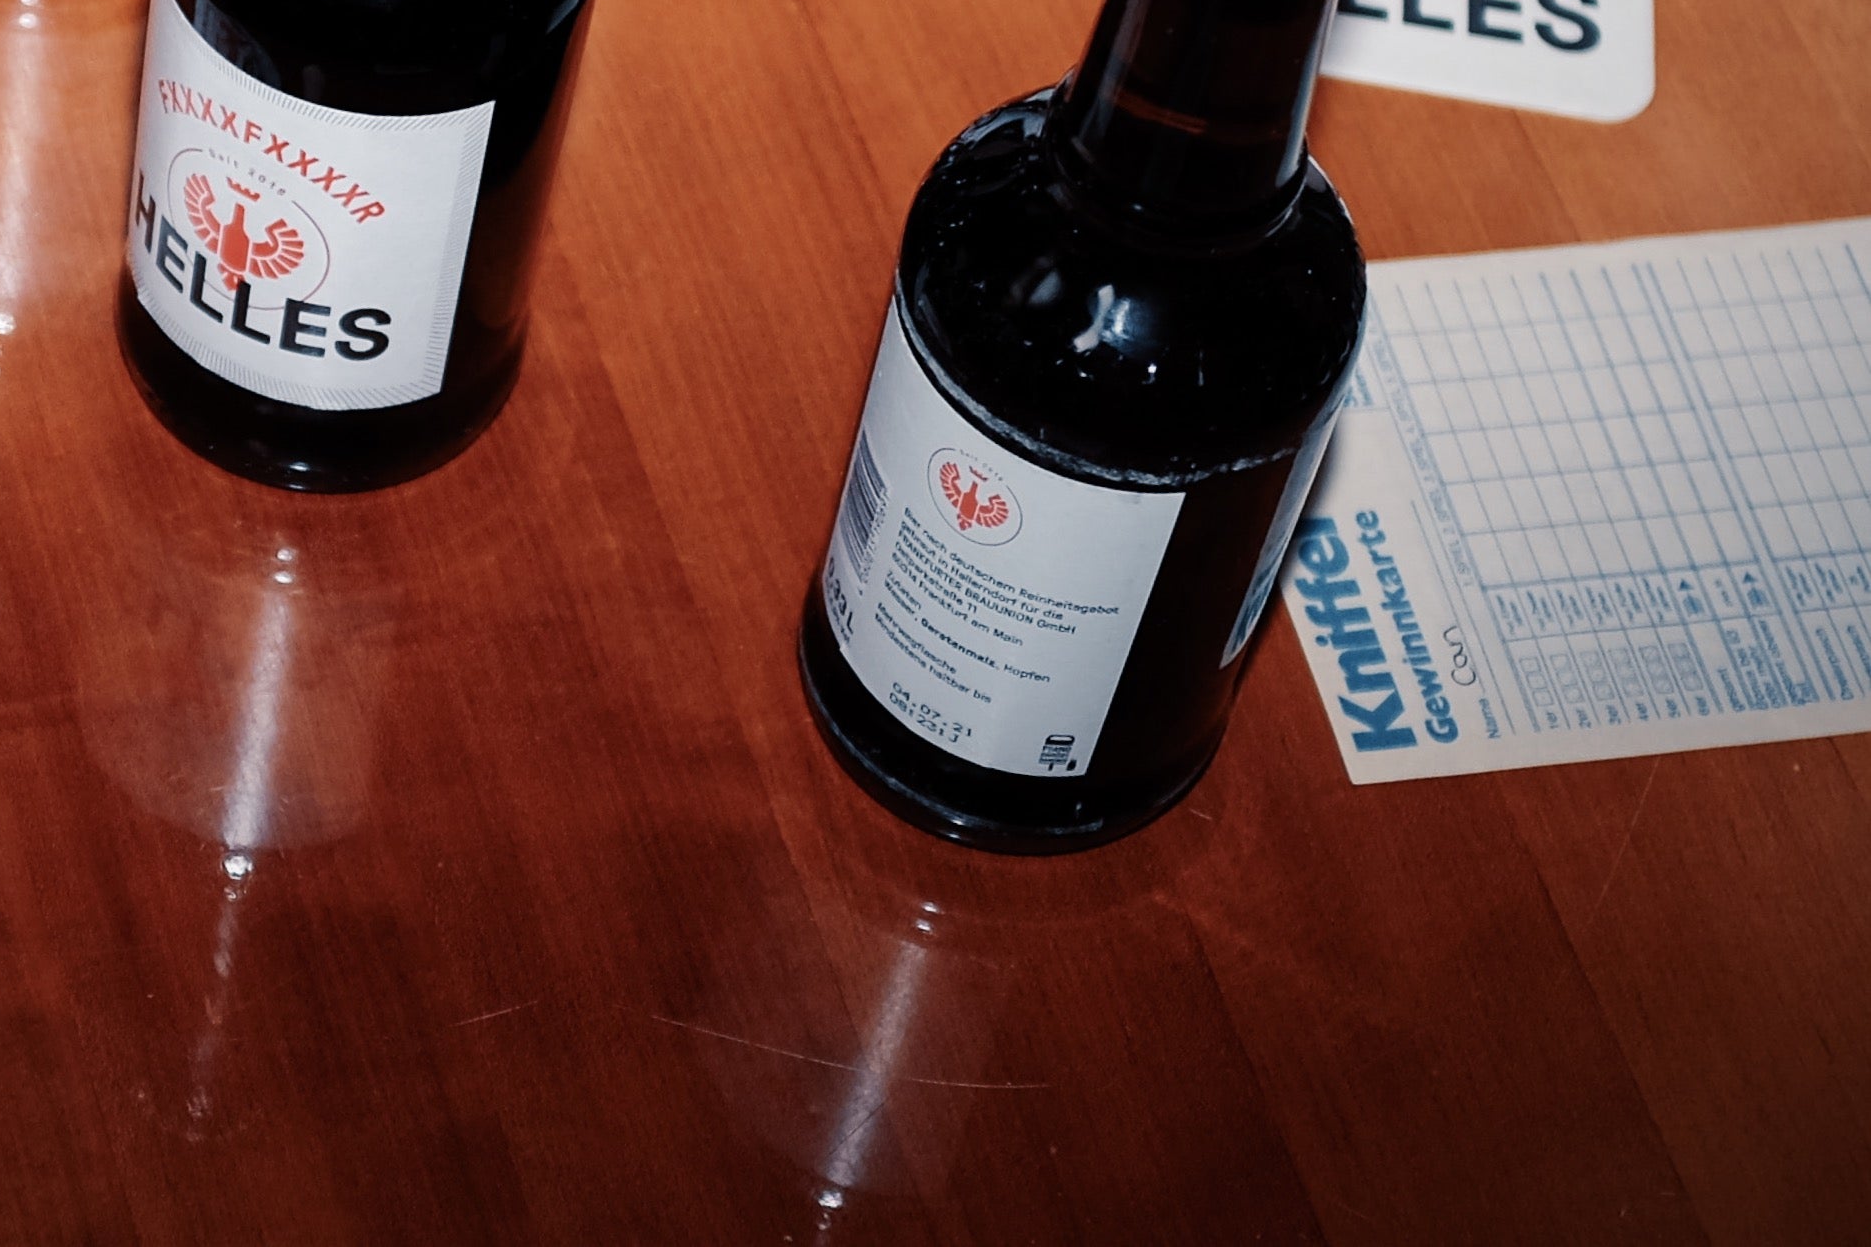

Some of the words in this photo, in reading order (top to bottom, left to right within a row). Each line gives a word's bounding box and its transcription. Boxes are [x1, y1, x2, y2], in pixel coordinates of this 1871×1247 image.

[158, 78, 386, 225] FXXXXFXXXXR
[134, 170, 392, 361] HELLES
[897, 530, 963, 591] FRANKFURTER
[964, 587, 1034, 626] BRAUUNION
[1035, 617, 1077, 637] GmbH
[918, 579, 968, 622] Frankfurt
[970, 618, 991, 634] am
[992, 628, 1024, 647] Main
[949, 552, 1016, 594] deutschem
[1018, 587, 1120, 616] Reinheitsgebot
[1020, 600, 1040, 615] für
[1042, 608, 1064, 622] die
[1294, 515, 1419, 753] Kniffel
[1355, 509, 1460, 744] Gewinnkarte
[928, 664, 970, 695] haltbar
[973, 689, 993, 705] bis
[1003, 663, 1052, 684] Hopfen
[892, 682, 973, 738] 04.07.21
[1478, 697, 1501, 740] Name
